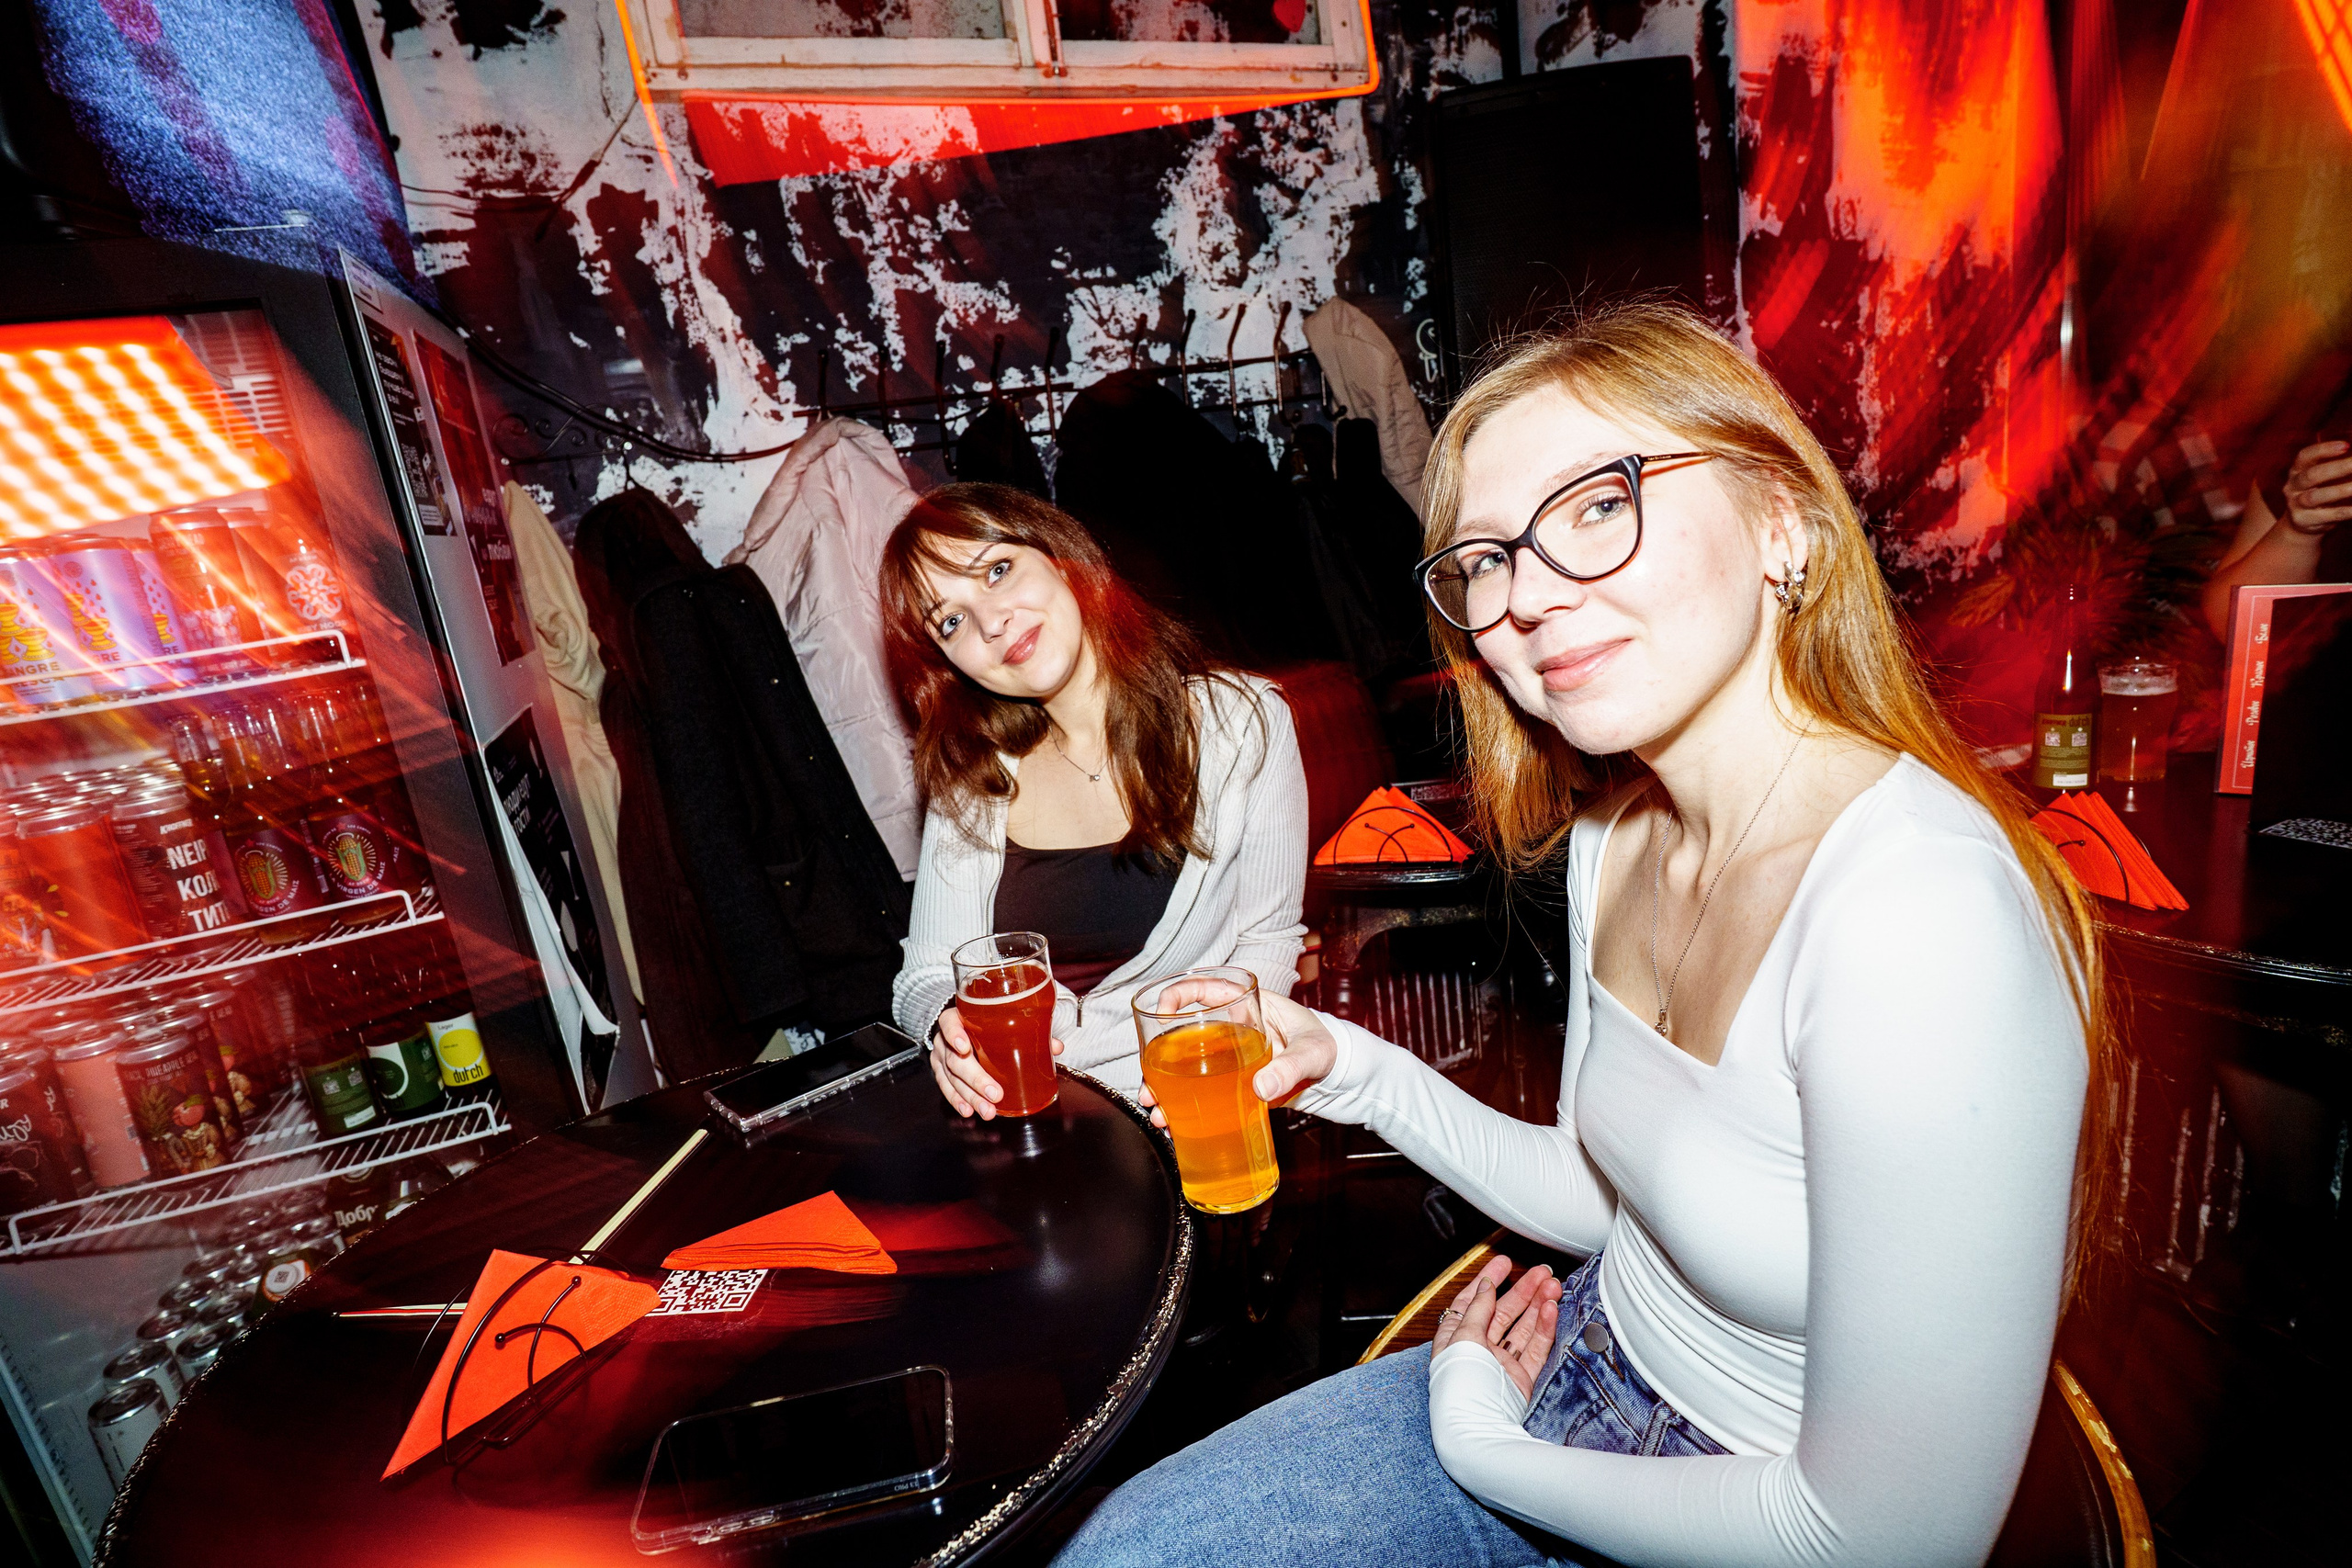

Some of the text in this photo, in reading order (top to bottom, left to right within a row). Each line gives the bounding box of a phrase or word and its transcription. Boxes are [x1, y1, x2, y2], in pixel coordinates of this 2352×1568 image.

[288, 879, 300, 899] MAIZ
[336, 883, 367, 895] VIRGEN
[368, 879, 379, 891] DE
[376, 861, 386, 881] MAIZ
